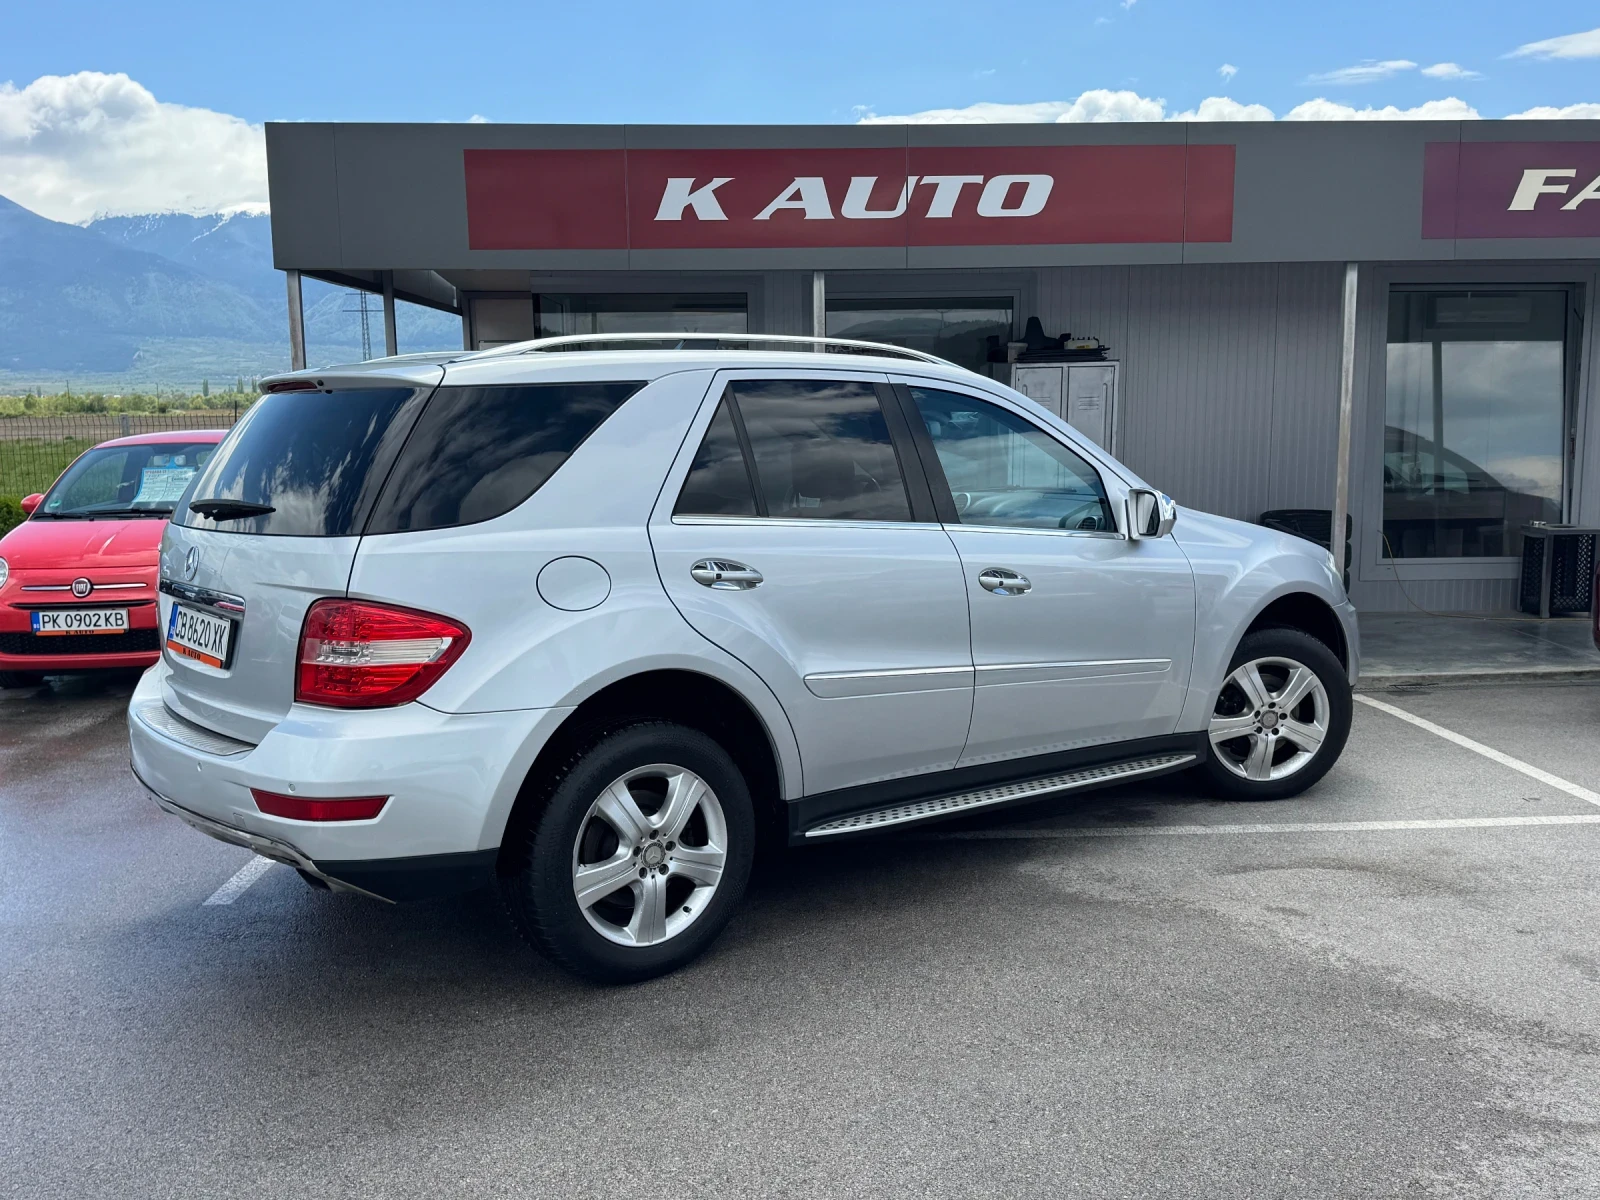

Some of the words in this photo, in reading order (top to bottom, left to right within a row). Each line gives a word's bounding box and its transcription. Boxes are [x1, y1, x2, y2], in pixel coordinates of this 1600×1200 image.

[653, 177, 736, 221] K
[752, 174, 1055, 220] AUTO
[75, 583, 87, 593] FIAT
[41, 613, 62, 629] PK
[65, 612, 102, 628] 0902
[104, 612, 125, 627] KB
[175, 610, 188, 639] CB
[187, 615, 211, 648] 8620
[211, 622, 227, 655] XK
